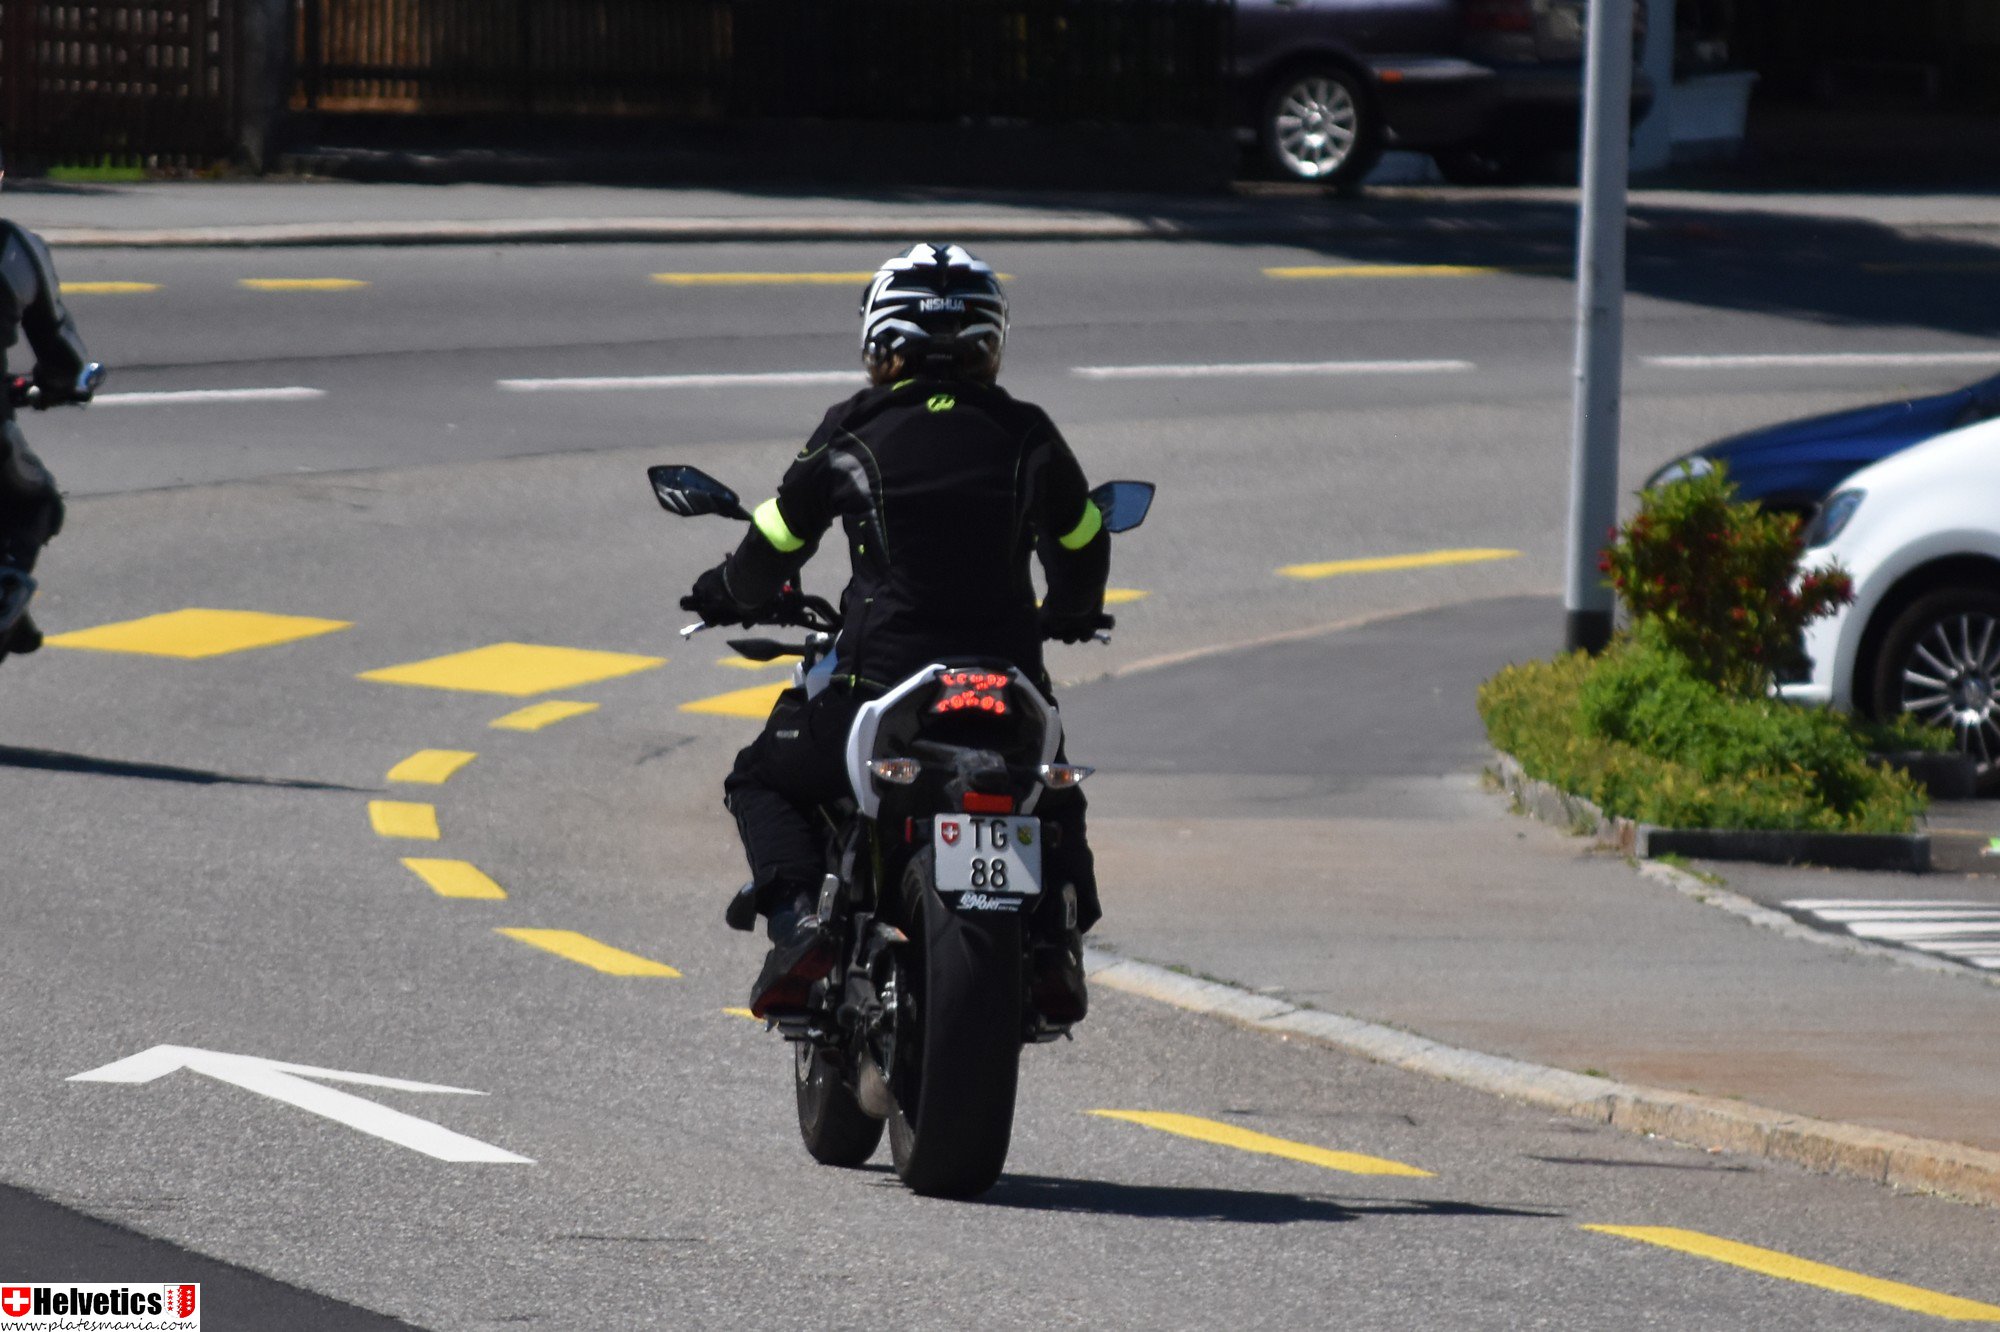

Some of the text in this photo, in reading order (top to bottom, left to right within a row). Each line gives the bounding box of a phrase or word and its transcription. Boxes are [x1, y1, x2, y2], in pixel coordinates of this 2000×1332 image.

[919, 298, 966, 312] NISHUA
[969, 818, 1008, 850] TG
[971, 858, 1006, 888] 88
